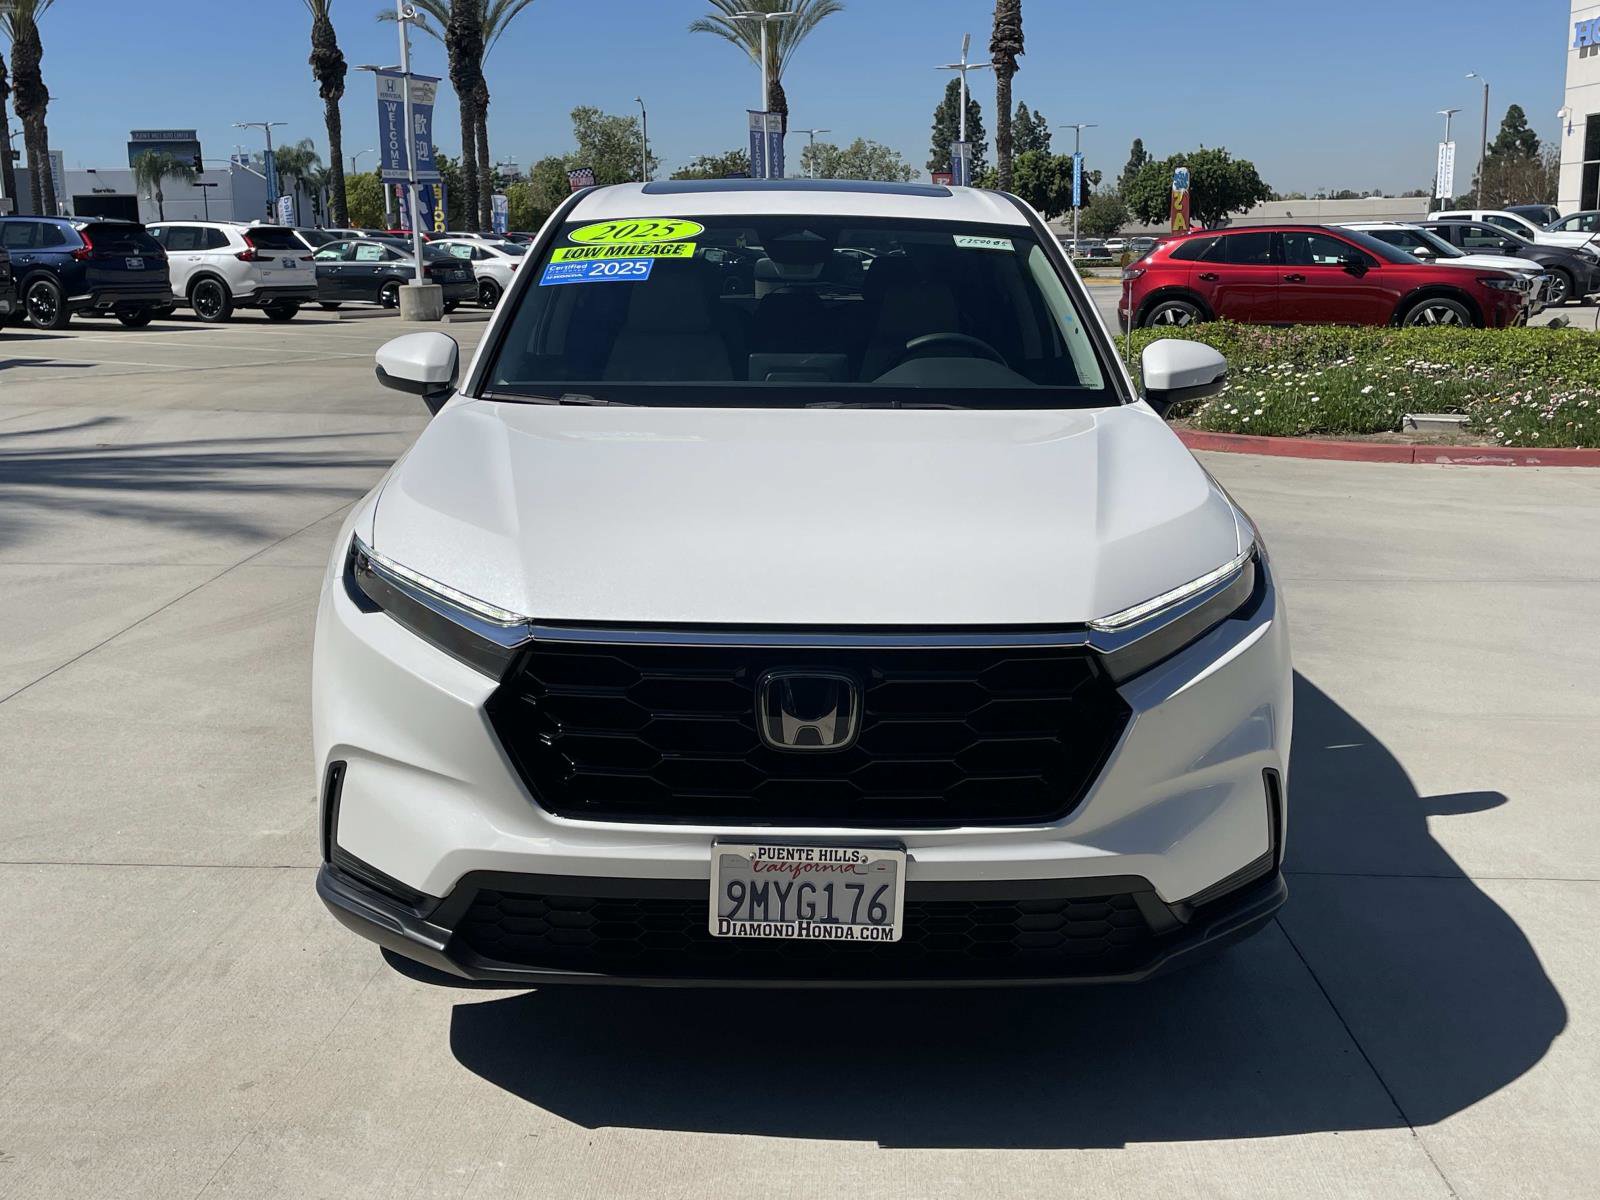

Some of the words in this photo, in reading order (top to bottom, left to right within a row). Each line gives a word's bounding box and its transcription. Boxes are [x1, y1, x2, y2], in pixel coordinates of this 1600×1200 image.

[385, 102, 400, 169] WELCOME
[590, 222, 683, 241] 2025
[562, 246, 604, 260] LOW
[604, 243, 687, 258] MILEAGE
[549, 263, 588, 271] Certified
[589, 261, 649, 276] 2025
[757, 846, 814, 861] PUENTE
[818, 848, 860, 862] HILLS
[752, 860, 868, 879] California
[726, 880, 890, 925] 9MYG176
